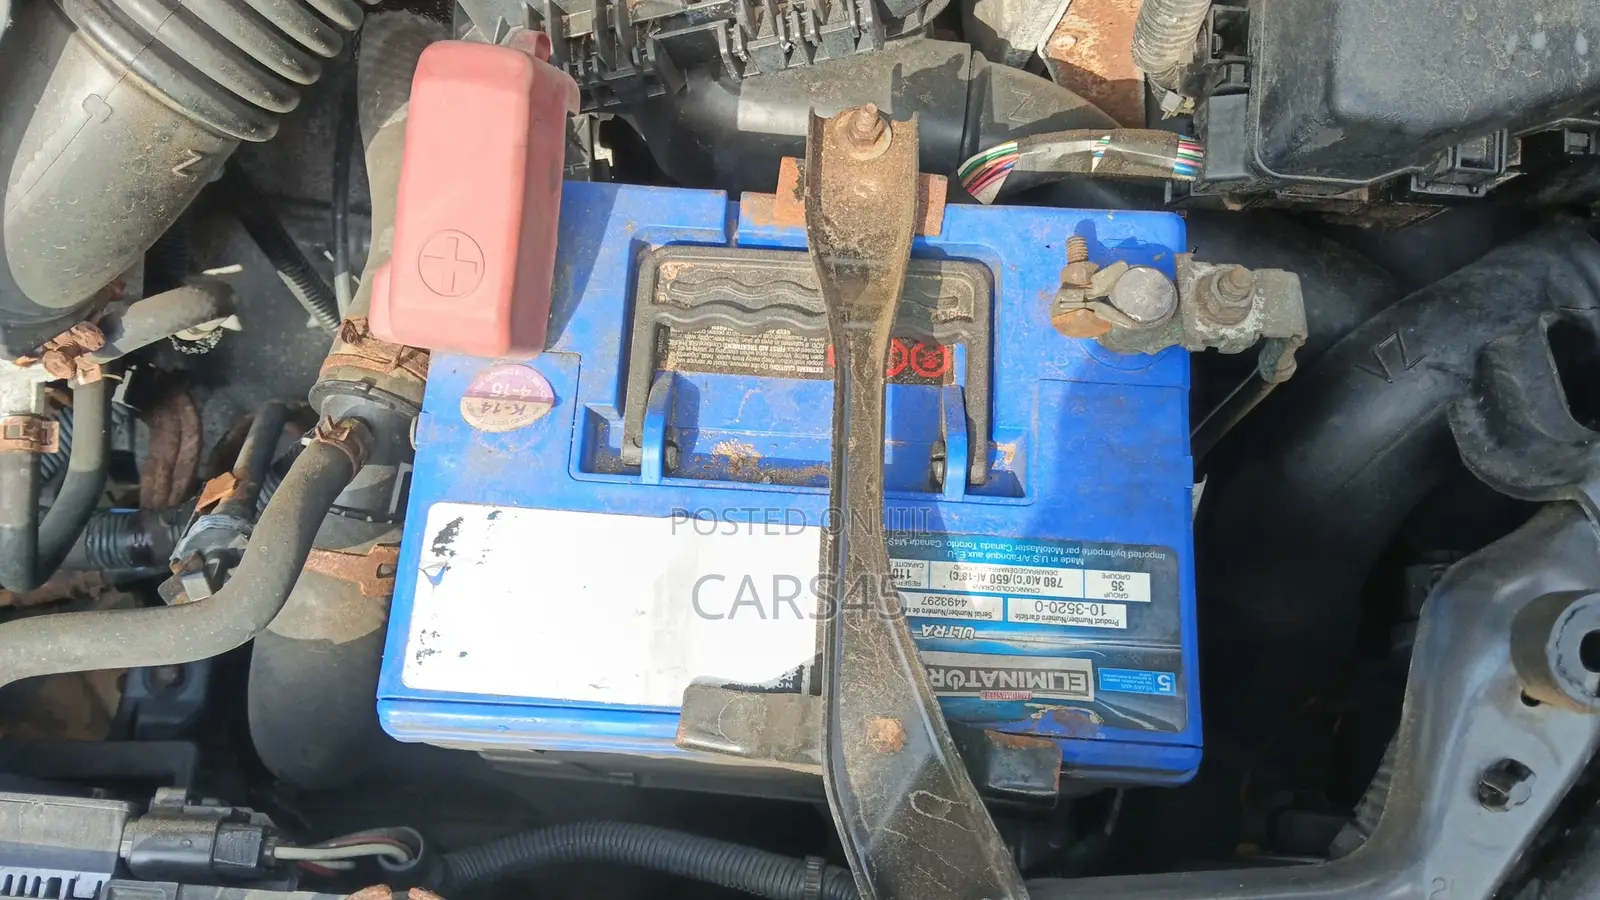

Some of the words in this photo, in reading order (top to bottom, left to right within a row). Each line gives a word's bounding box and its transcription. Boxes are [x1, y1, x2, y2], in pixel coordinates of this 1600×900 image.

[980, 542, 1013, 551] Canada
[1015, 545, 1064, 555] MotoMaster
[1066, 546, 1080, 554] par
[1051, 556, 1059, 564] in
[1060, 556, 1084, 565] Made
[1128, 551, 1166, 560] Imported
[893, 568, 912, 579] 110
[1044, 576, 1063, 588] 780
[1111, 580, 1125, 591] 35
[921, 596, 967, 608] 4493297
[1034, 600, 1107, 616] 10-3520-0
[974, 611, 992, 619] Serial
[1094, 618, 1119, 627] Product
[921, 624, 976, 640] ULTRA
[927, 668, 1087, 692] ELIMINATOR
[1157, 674, 1171, 691] 5
